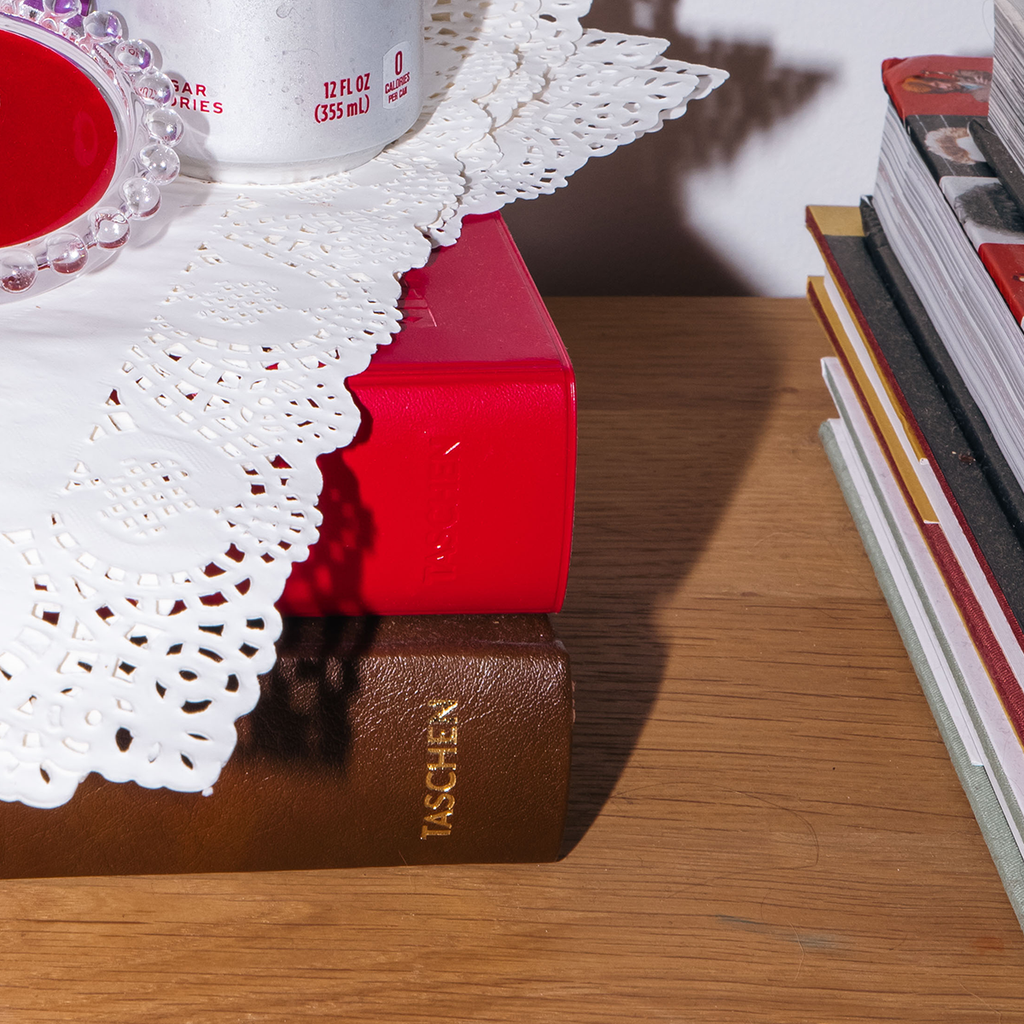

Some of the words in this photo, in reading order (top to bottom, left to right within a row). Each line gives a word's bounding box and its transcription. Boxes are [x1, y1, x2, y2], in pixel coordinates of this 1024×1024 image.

[395, 51, 403, 75] 0
[323, 81, 337, 99] 12
[340, 78, 353, 96] FL
[356, 73, 370, 92] OZ
[385, 72, 410, 94] CALORIES
[388, 92, 398, 103] PER
[399, 86, 408, 98] CAN
[314, 102, 343, 123] (355
[347, 94, 370, 117] mL)
[422, 436, 461, 585] TASCHEN
[421, 700, 458, 840] TASCHEN
